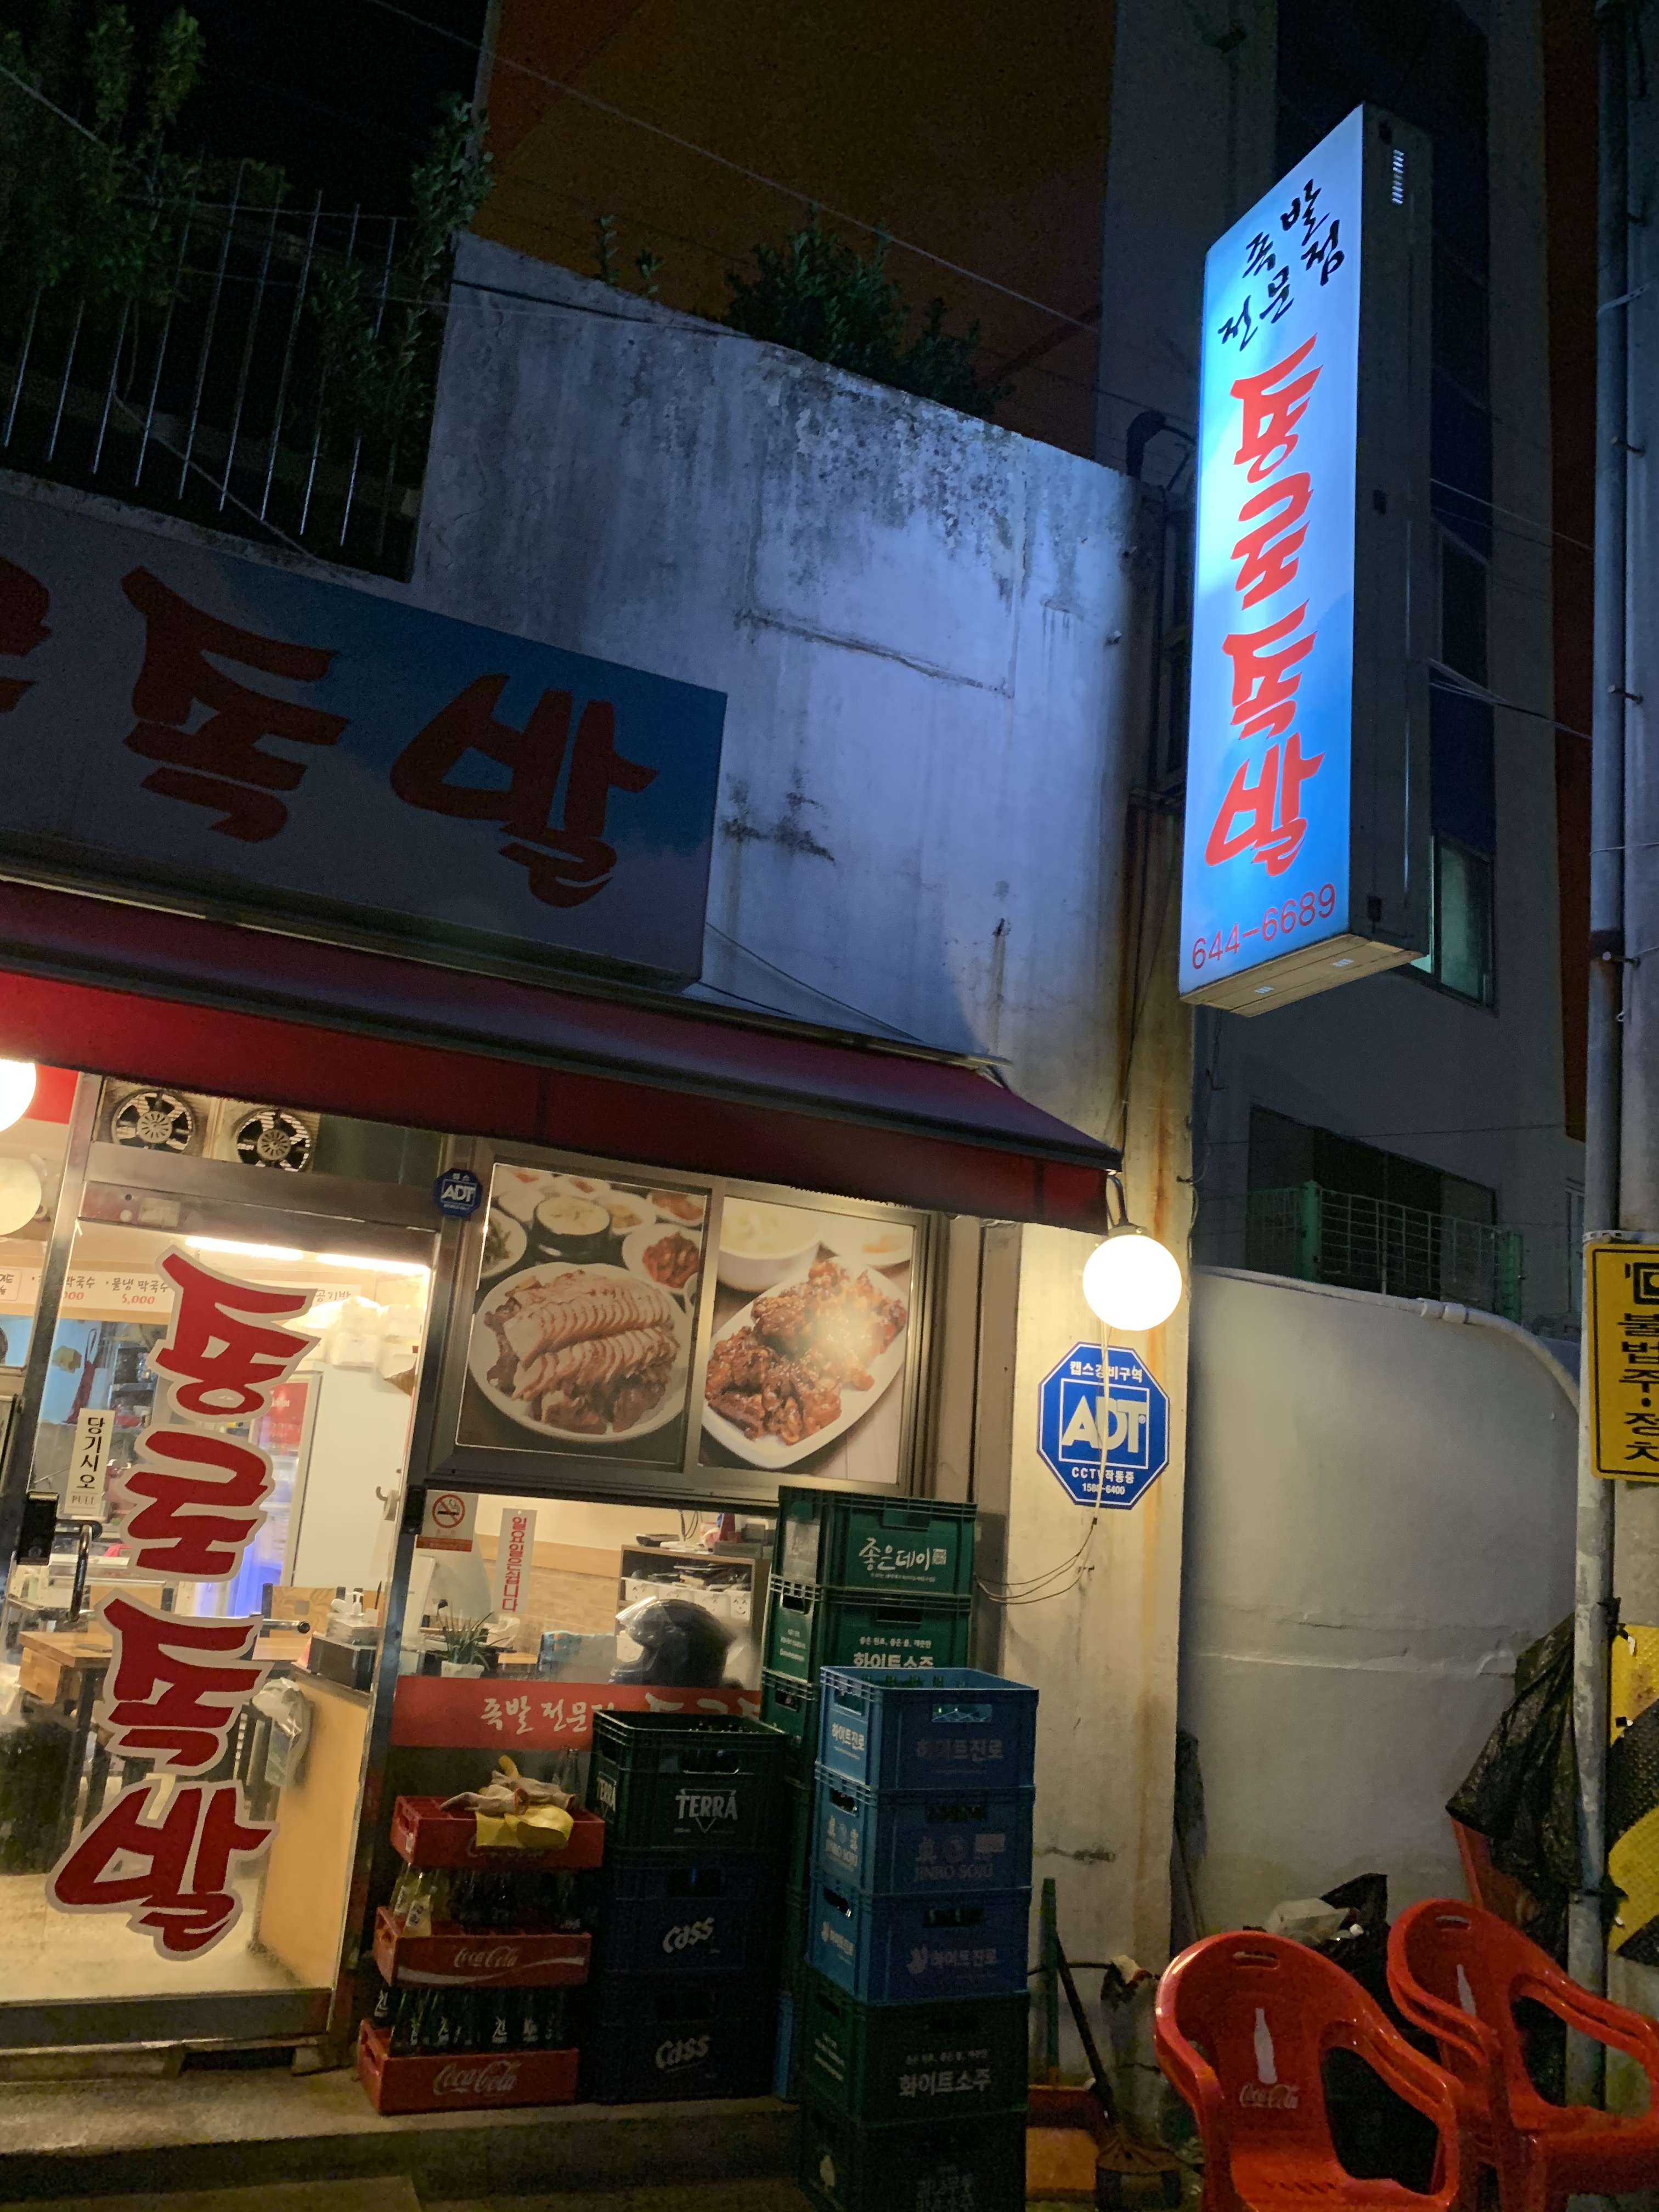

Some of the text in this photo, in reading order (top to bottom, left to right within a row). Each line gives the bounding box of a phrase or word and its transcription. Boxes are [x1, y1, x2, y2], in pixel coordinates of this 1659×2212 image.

[1217, 219, 1345, 352] 전문점
[0, 556, 659, 908] 족발
[1191, 883, 1336, 970] 644-6689
[441, 1184, 476, 1203] ADT
[111, 1277, 133, 1291] 물냉
[122, 1293, 155, 1305] 5,000
[1061, 1395, 1147, 1454] ADT
[76, 1417, 106, 1489] 당기시오
[71, 1494, 95, 1505] PULL
[481, 1695, 534, 1735] 족발
[675, 1795, 738, 1820] TERRA
